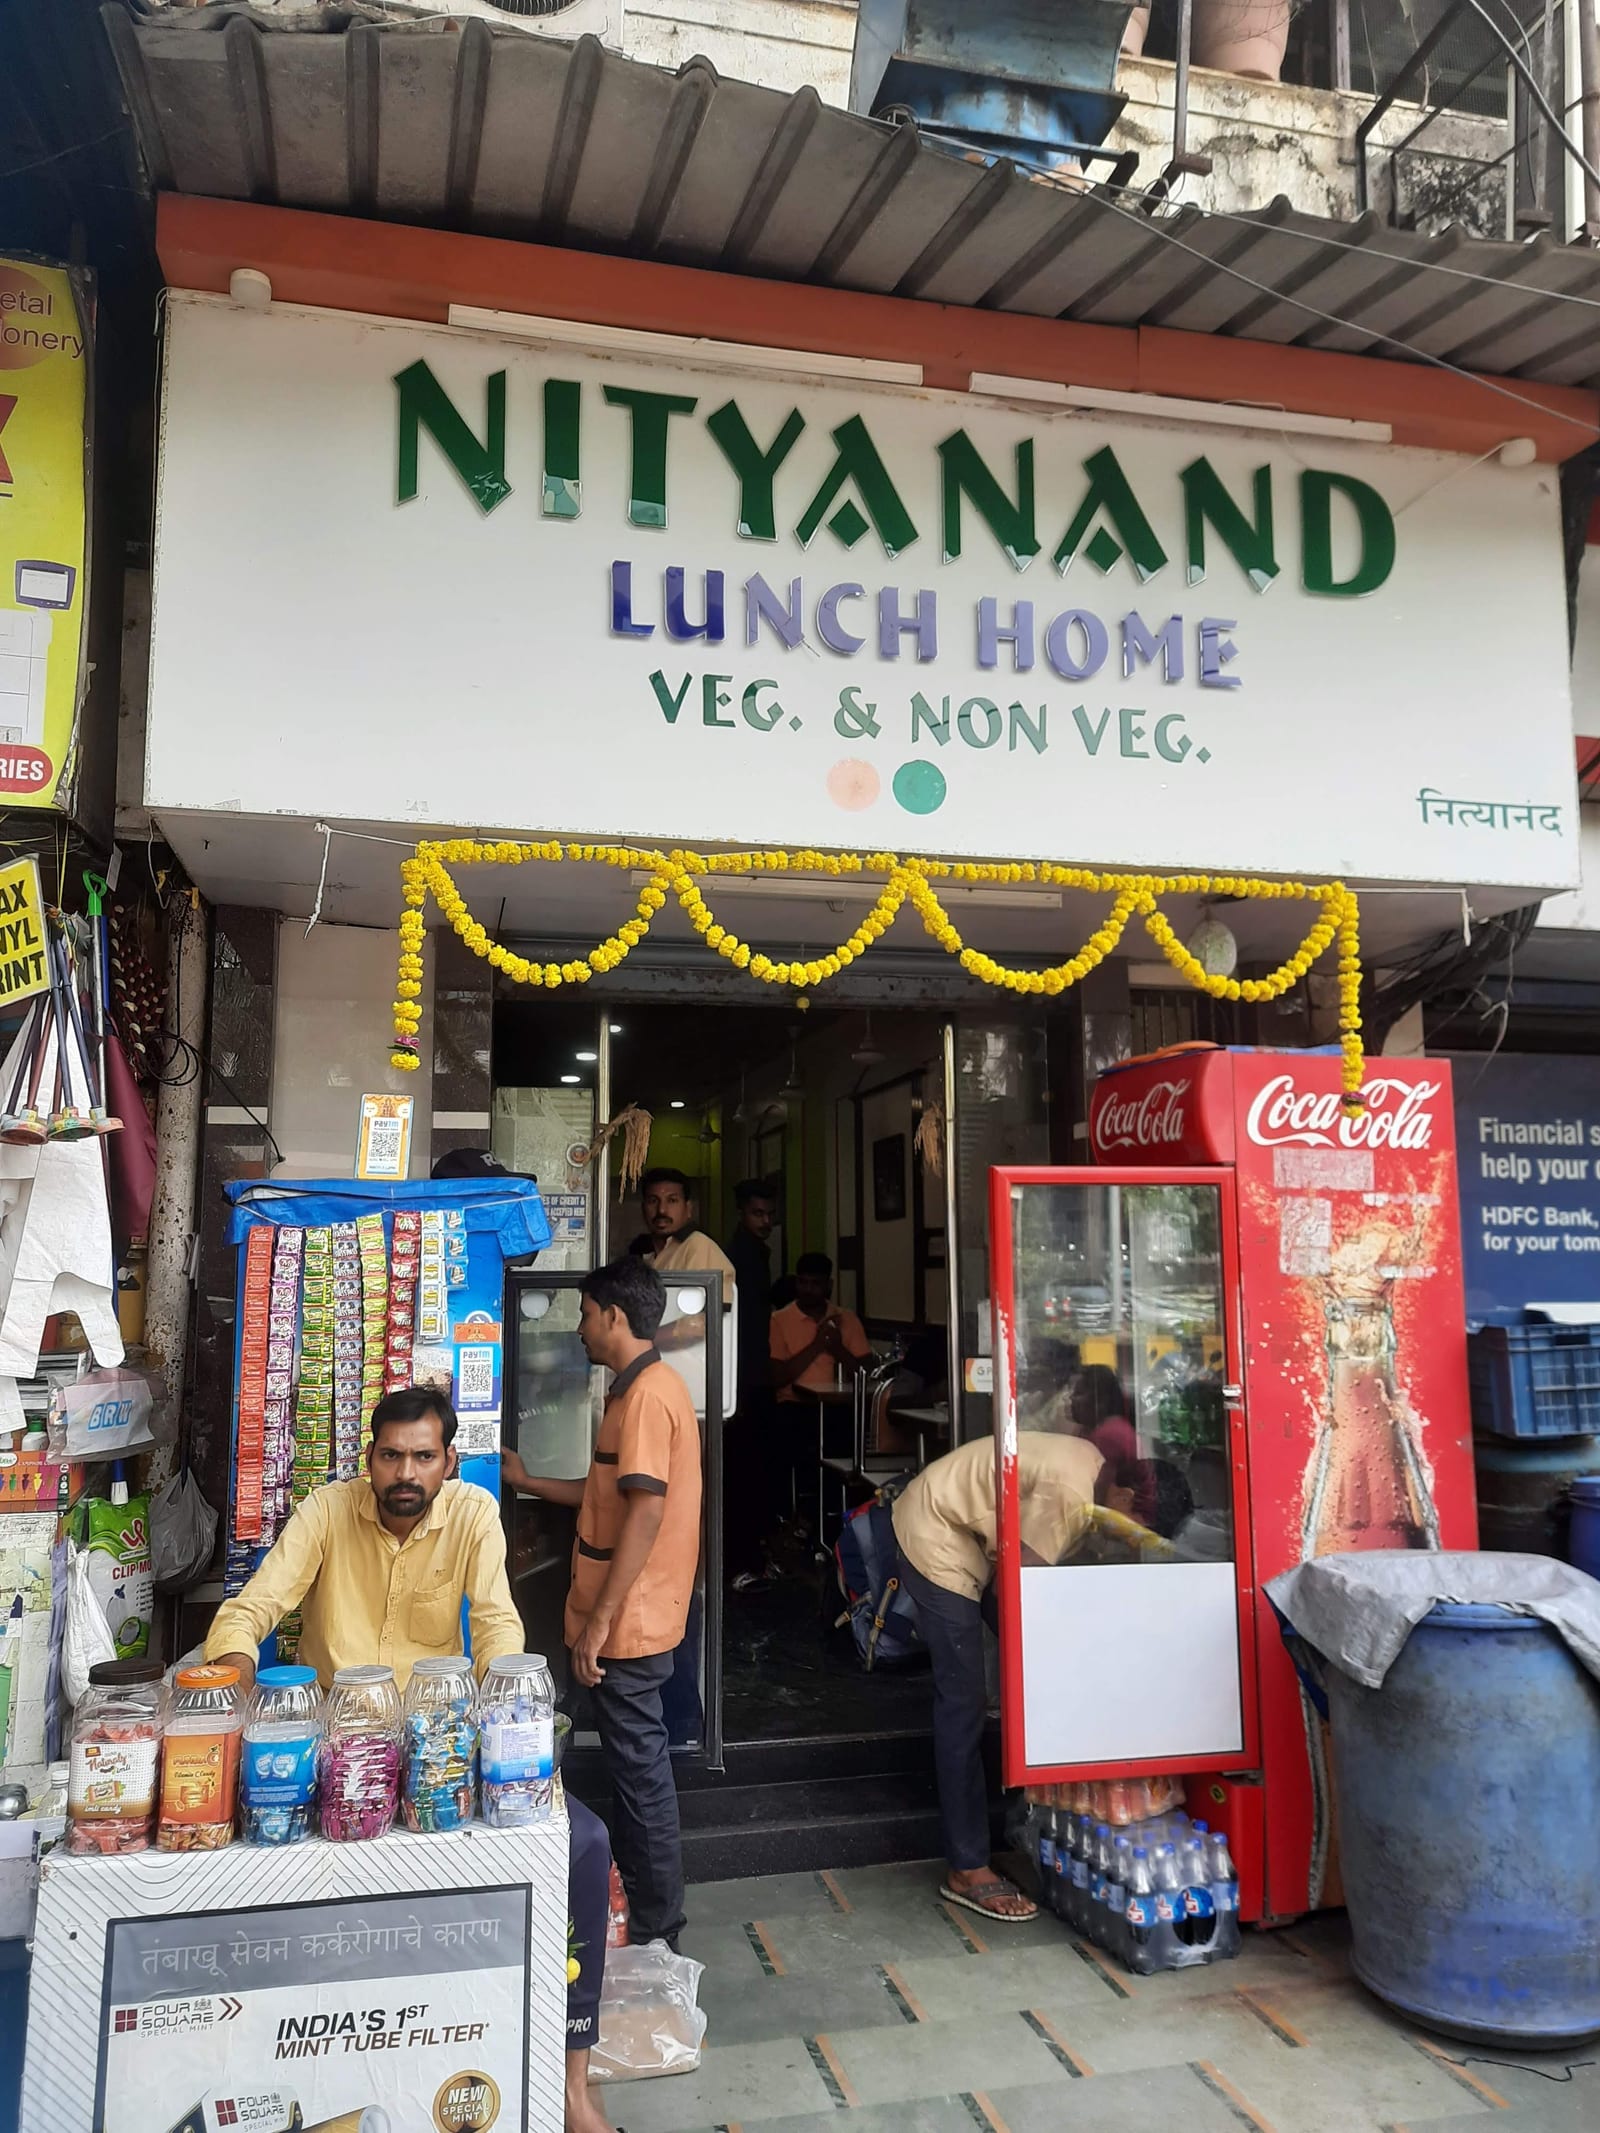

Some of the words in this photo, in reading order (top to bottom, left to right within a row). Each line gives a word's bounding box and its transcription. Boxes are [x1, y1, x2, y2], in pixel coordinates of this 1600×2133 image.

[0, 290, 52, 316] etal
[3, 327, 84, 359] onery
[391, 358, 1397, 597] NITYANAND
[609, 559, 939, 662] LUNCH
[976, 594, 1242, 688] HOME
[648, 669, 804, 732] VEG.
[833, 686, 882, 739] &
[911, 690, 1048, 754] NON
[1072, 704, 1212, 764] VEG.
[0, 758, 44, 781] RIES
[1415, 787, 1563, 837] नित्यानंद
[0, 879, 29, 915] AX
[1246, 1074, 1442, 1149] CocaCola
[1479, 1117, 1584, 1146] Financial
[1481, 1151, 1532, 1184] help
[1537, 1157, 1589, 1184] your
[1481, 1205, 1540, 1226] HDFC
[1543, 1206, 1600, 1230] Bank,
[1483, 1231, 1512, 1251] for
[1515, 1235, 1560, 1256] your
[1563, 1233, 1600, 1252] tom
[112, 1563, 136, 1580] CLIP
[140, 1938, 228, 1977] तंबाखू
[229, 1930, 291, 1966] सेवन
[300, 1914, 424, 1960] कर्करोगाचे
[432, 1917, 501, 1947] कारण
[141, 2012, 214, 2030] SQUARE
[142, 2002, 190, 2018] FOUR
[140, 2027, 184, 2038] SPECIAL
[189, 2023, 214, 2032] MINT
[275, 2037, 335, 2060] MINT
[342, 2031, 403, 2052] TUBE
[237, 2095, 270, 2108] FOUR
[448, 2084, 486, 2105] NEW
[241, 2104, 285, 2122] SQUARE
[442, 2103, 490, 2116] SPECIAL
[452, 2111, 480, 2123] MINT
